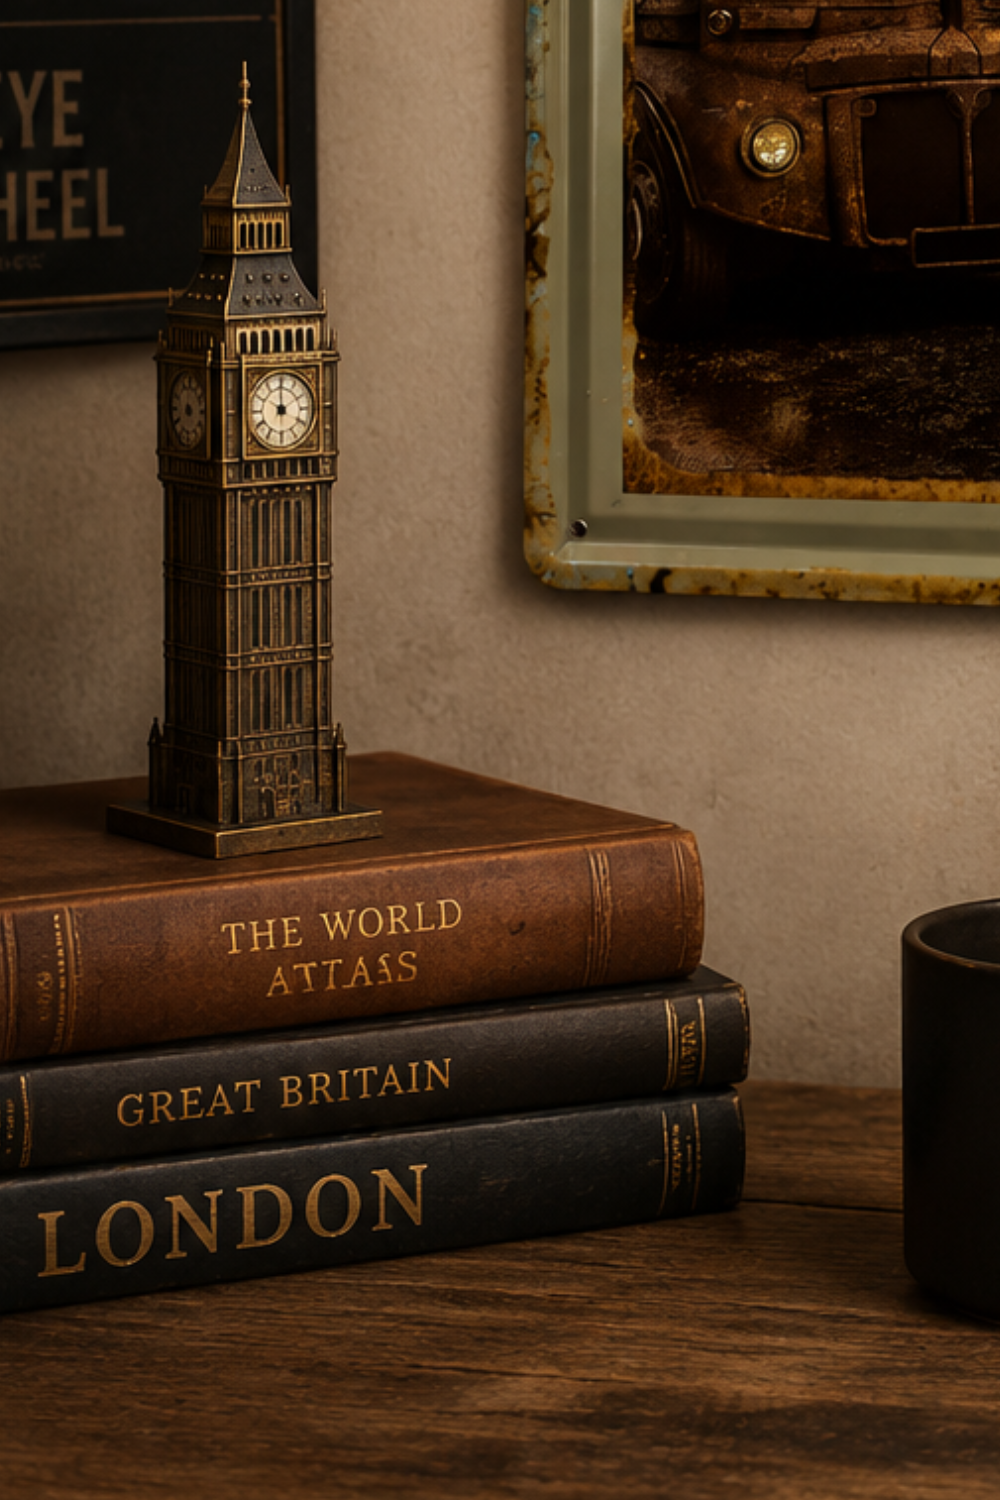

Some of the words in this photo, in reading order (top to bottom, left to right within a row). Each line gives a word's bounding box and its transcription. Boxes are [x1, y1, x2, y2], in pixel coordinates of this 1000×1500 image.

[0, 69, 85, 150] YE
[220, 916, 304, 955] THE
[319, 898, 463, 942] WORLD
[116, 1079, 262, 1128] GREAT
[278, 1057, 453, 1110] BRITAIN
[37, 1164, 429, 1278] LONDON
